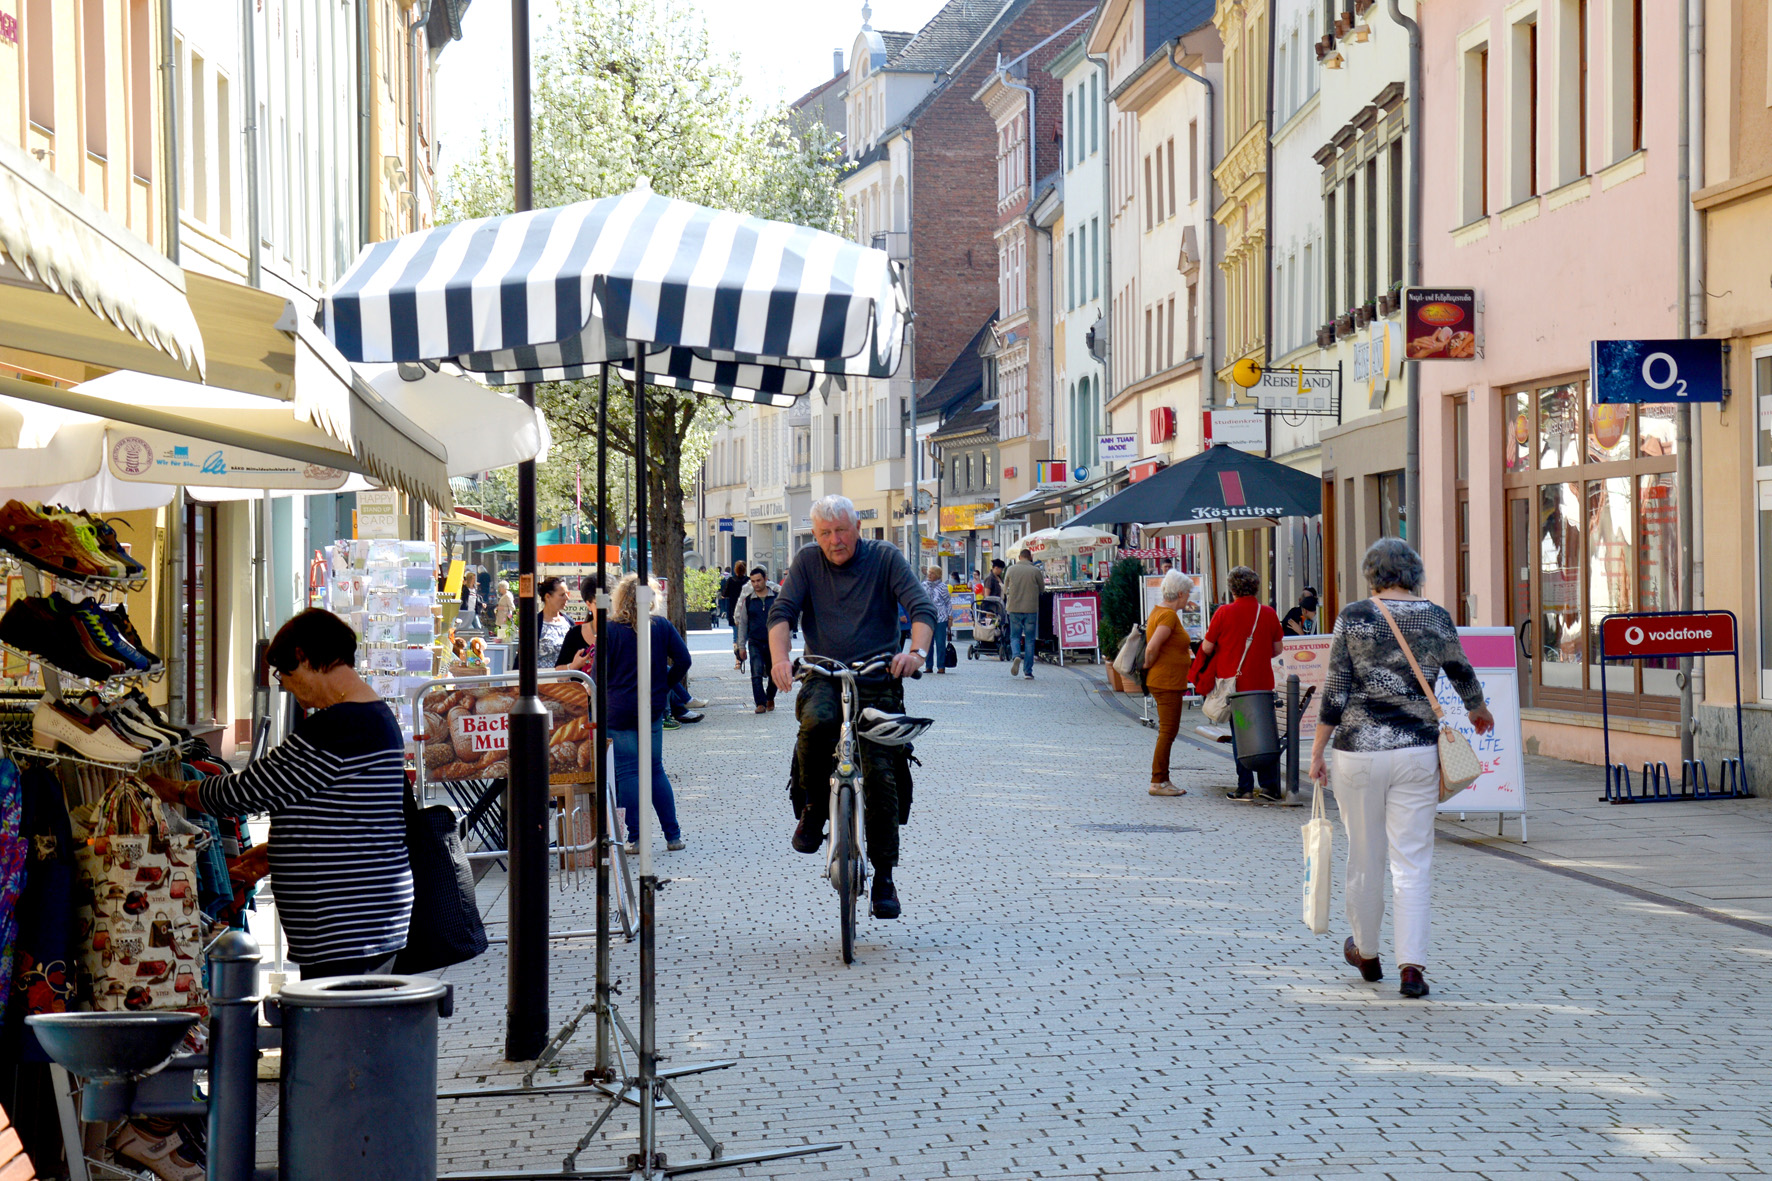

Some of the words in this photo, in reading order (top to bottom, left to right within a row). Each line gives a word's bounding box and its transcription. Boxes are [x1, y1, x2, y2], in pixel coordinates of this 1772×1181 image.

[1425, 293, 1434, 301] und
[360, 494, 393, 503] HAPPY
[1191, 506, 1284, 519] Köstritzer
[361, 516, 394, 525] CARD
[1029, 543, 1045, 552] NKD
[1648, 628, 1713, 641] vodafone
[1479, 739, 1505, 752] LTE
